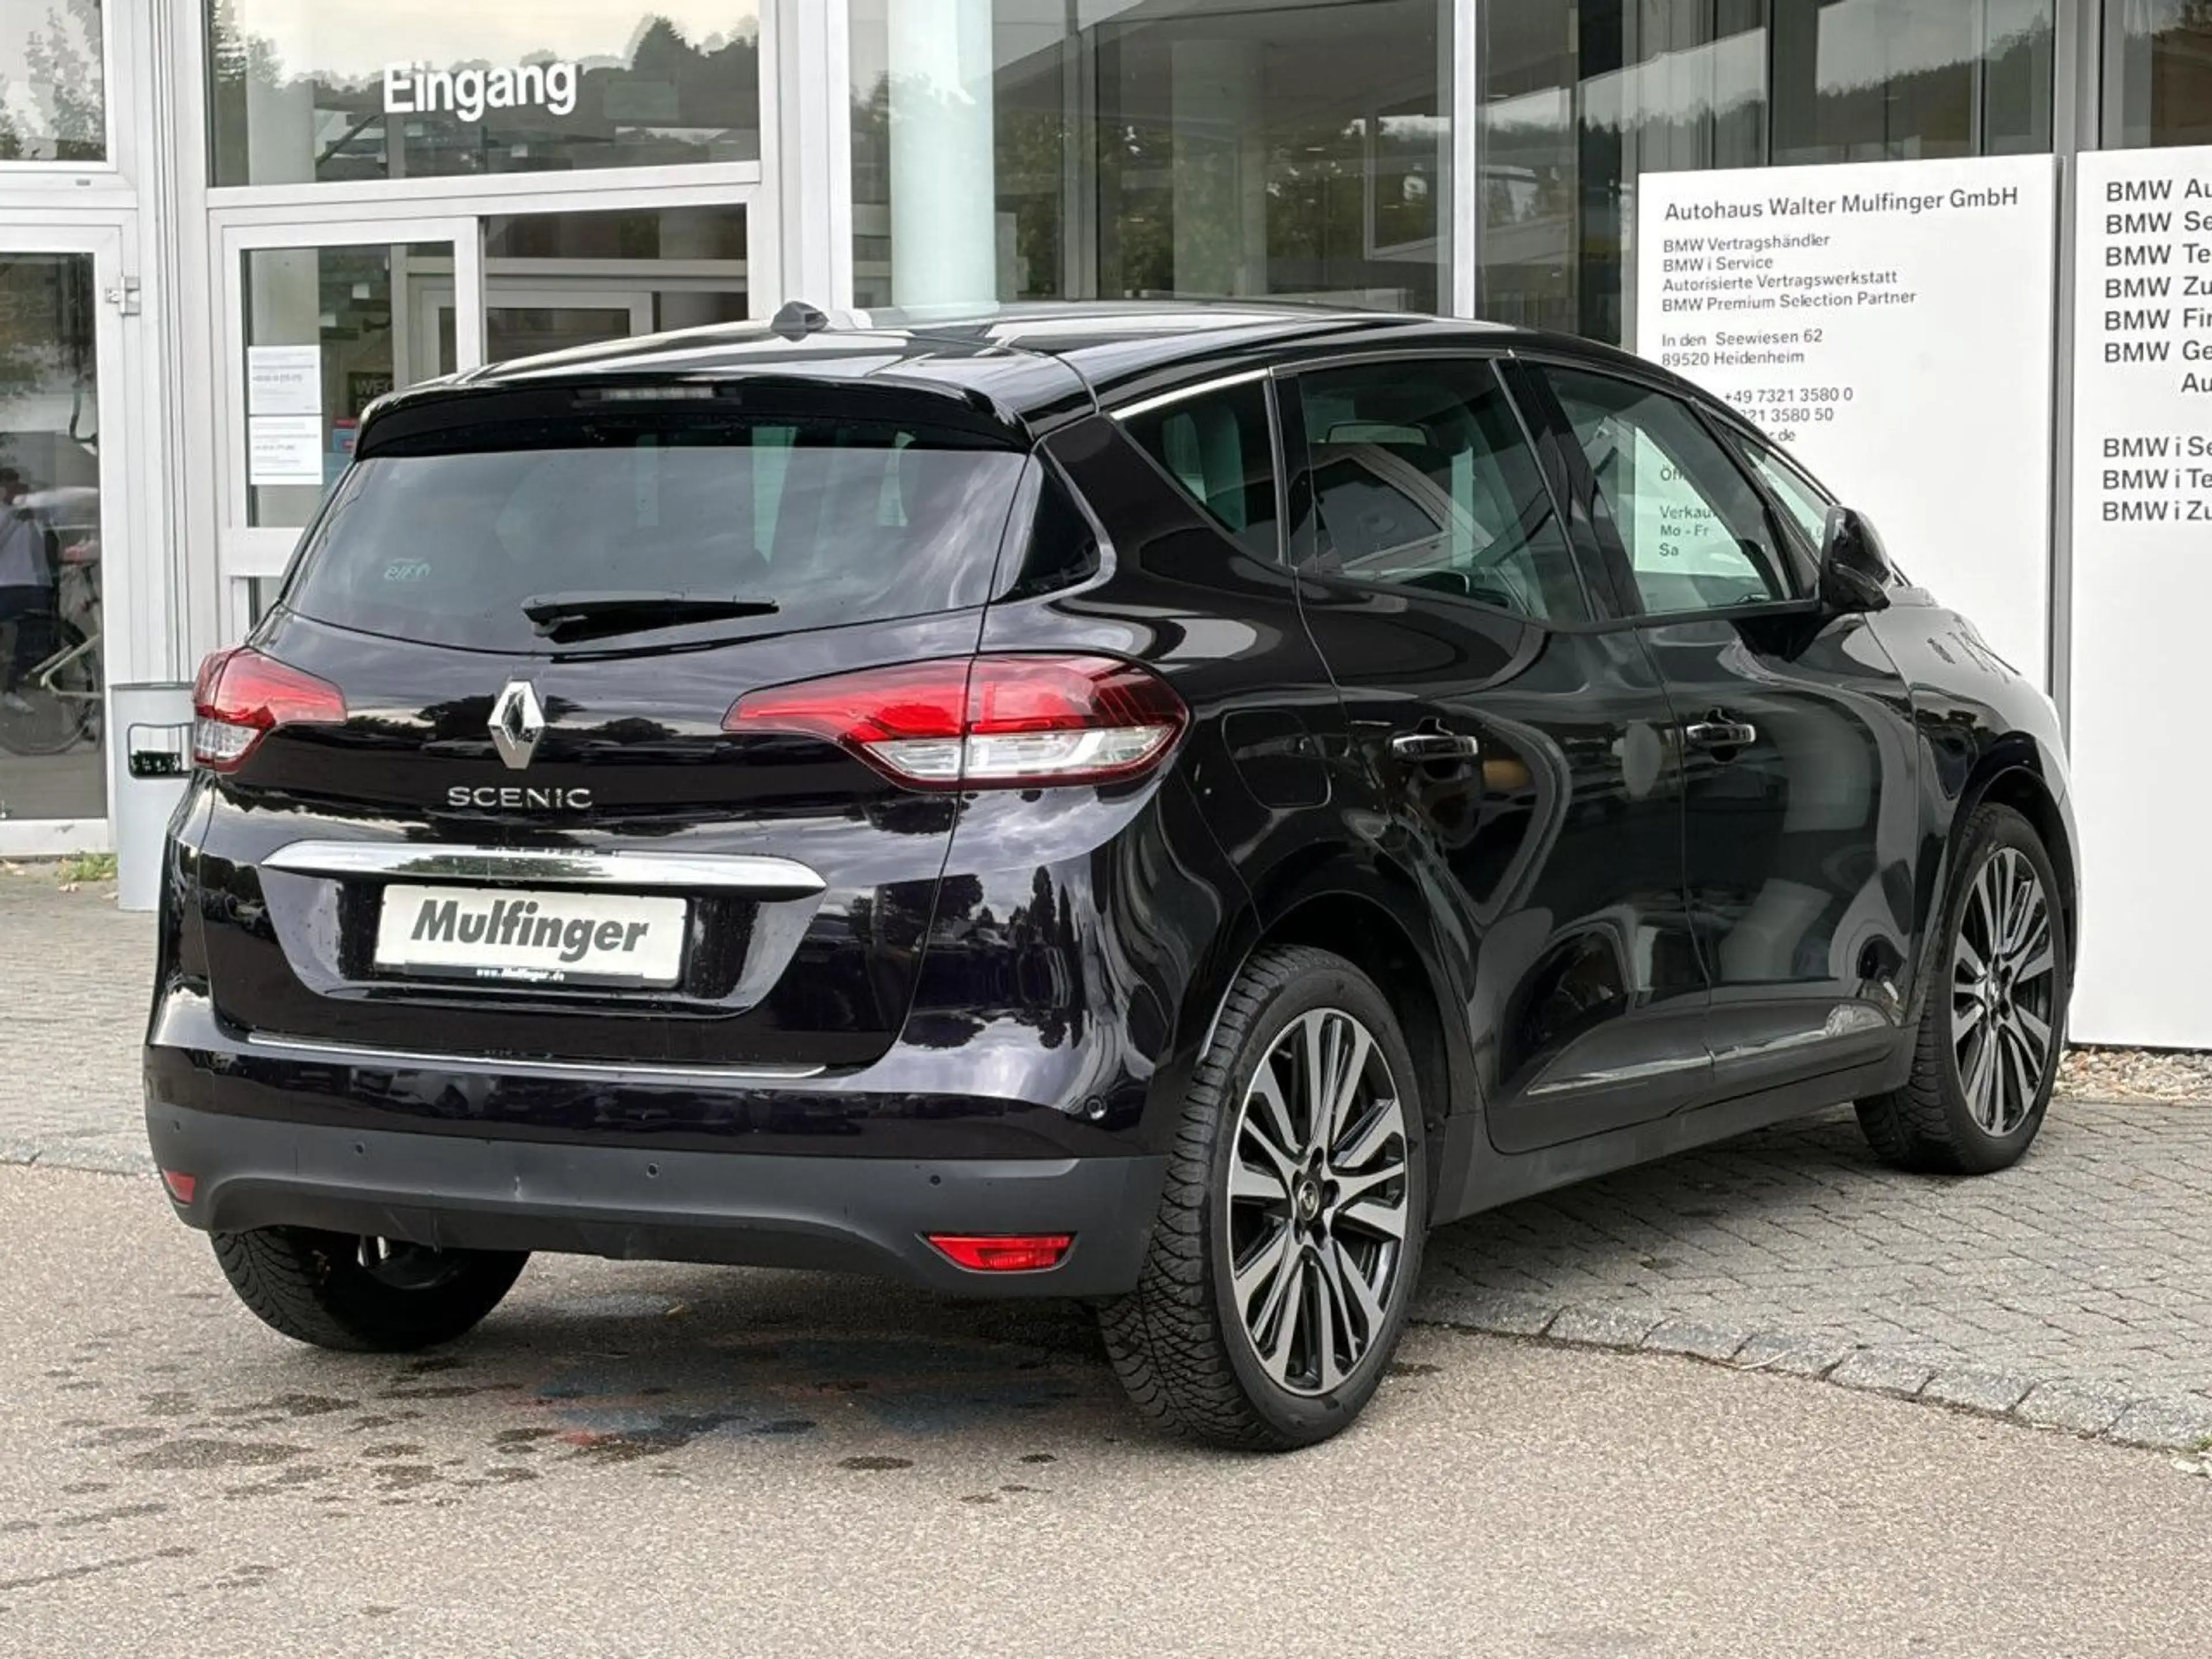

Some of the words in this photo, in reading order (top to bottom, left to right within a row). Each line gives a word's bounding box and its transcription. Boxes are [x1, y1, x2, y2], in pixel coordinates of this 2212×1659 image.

[384, 60, 576, 122] Eingang
[2106, 180, 2172, 202] BMW
[1665, 200, 1763, 221] Autohaus
[1769, 196, 1836, 215] Walter
[1842, 191, 1945, 214] Mulfinger
[1950, 187, 2018, 208] GmbH
[2106, 211, 2172, 234] BMW
[1663, 238, 1705, 253] BMW
[1707, 233, 1831, 252] Vertragshändler
[1662, 257, 1703, 272] BMW
[1707, 257, 1712, 271] i
[1715, 255, 1773, 271] Service
[2105, 244, 2171, 266] BMW
[2182, 243, 2211, 263] Te
[1662, 276, 1753, 292] Autorisierte
[1756, 270, 1897, 290] Vertragswerkstatt
[2105, 276, 2171, 298] BMW
[1662, 298, 1703, 312] BMW
[1707, 295, 1775, 311] Premium
[1779, 291, 1853, 308] Selection
[1857, 290, 1917, 305] Partner
[2105, 309, 2171, 331] BMW
[1662, 334, 1676, 347] In
[1679, 333, 1707, 347] den
[1715, 329, 1798, 346] Seewiesen
[1804, 328, 1823, 343] 62
[1662, 351, 1710, 367] 89520
[1714, 350, 1804, 365] Heidenheim
[2104, 341, 2171, 363] BMW
[1724, 389, 1752, 403] +49
[1757, 388, 1794, 403] 7321
[1800, 387, 1839, 402] 3580
[1843, 387, 1853, 401] 0
[1771, 407, 1810, 422] 3580
[1814, 407, 1834, 421] 50
[2103, 436, 2169, 458] BMW
[2175, 436, 2181, 457] i
[2103, 468, 2169, 490] BMW
[2175, 468, 2180, 488] i
[2103, 501, 2168, 521] BMW
[2174, 499, 2180, 520] i
[1661, 525, 1681, 536] Mo
[1694, 524, 1709, 536] Fr
[1659, 543, 1679, 556] Sa
[448, 786, 592, 808] SCENIC
[411, 899, 649, 963] Mulfinger
